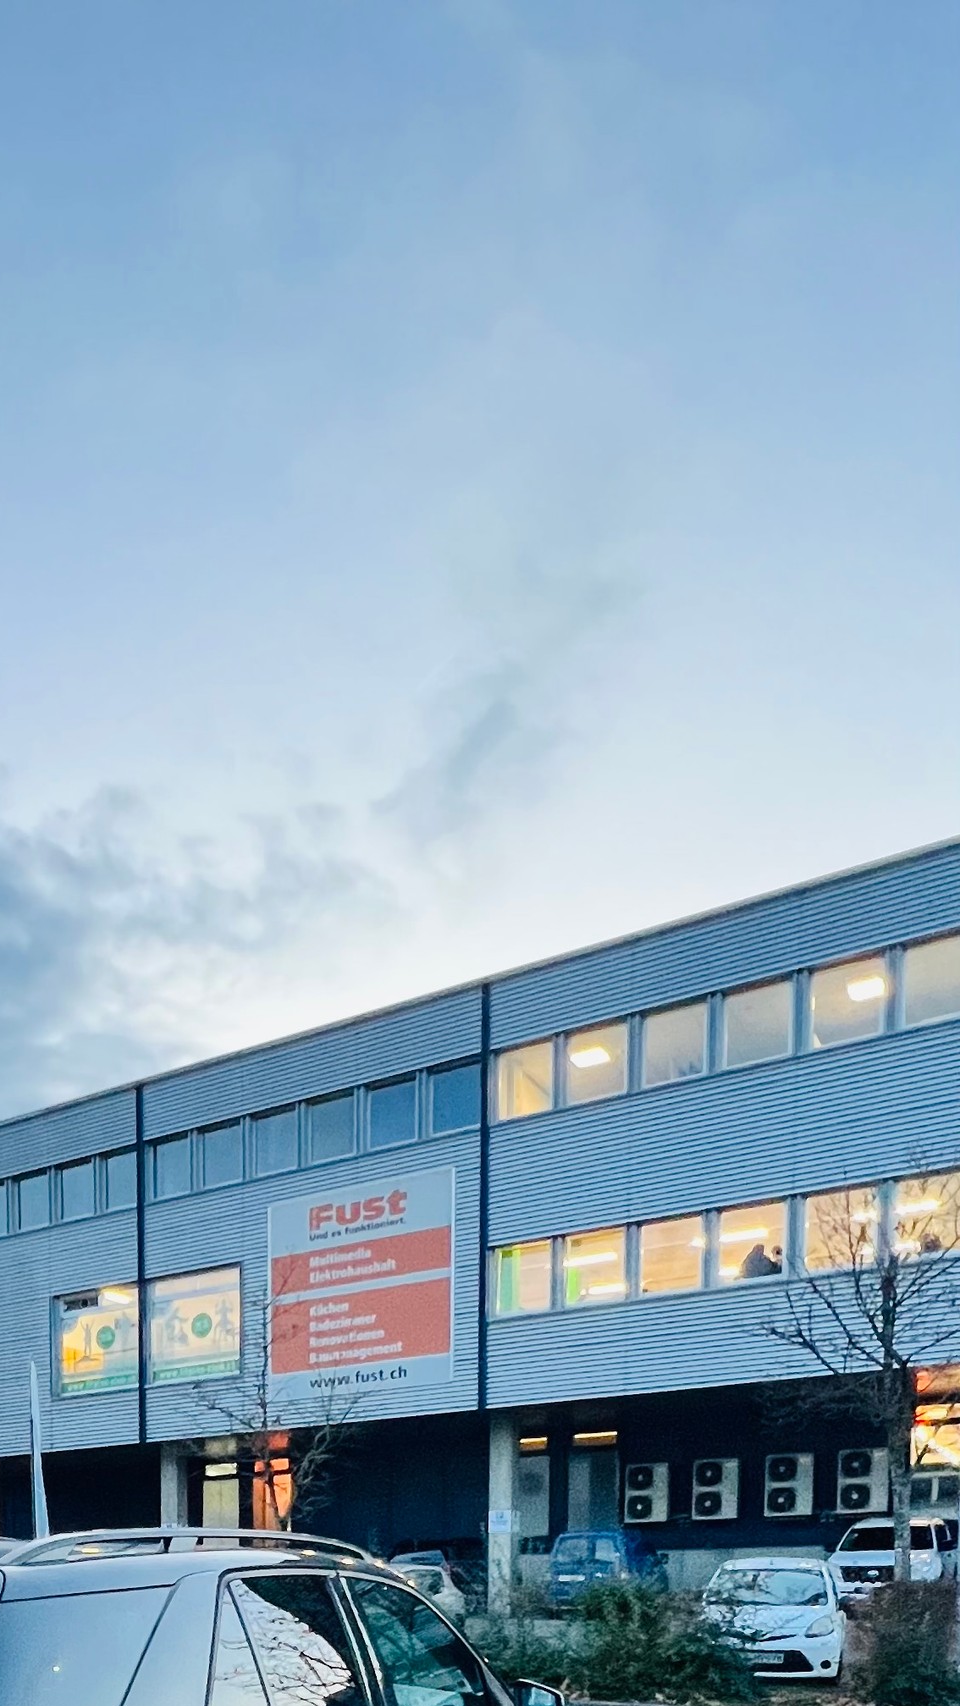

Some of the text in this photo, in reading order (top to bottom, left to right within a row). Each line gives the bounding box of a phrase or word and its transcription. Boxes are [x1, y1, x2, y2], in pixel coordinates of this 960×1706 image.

[309, 1231, 328, 1242] Und
[331, 1230, 342, 1238] es
[309, 1247, 371, 1269] Multimedia
[309, 1258, 396, 1284] Elektrohaushalt
[309, 1302, 349, 1317] Küchen
[309, 1314, 377, 1332] Badezimmer
[309, 1366, 407, 1388] www.fust.ch
